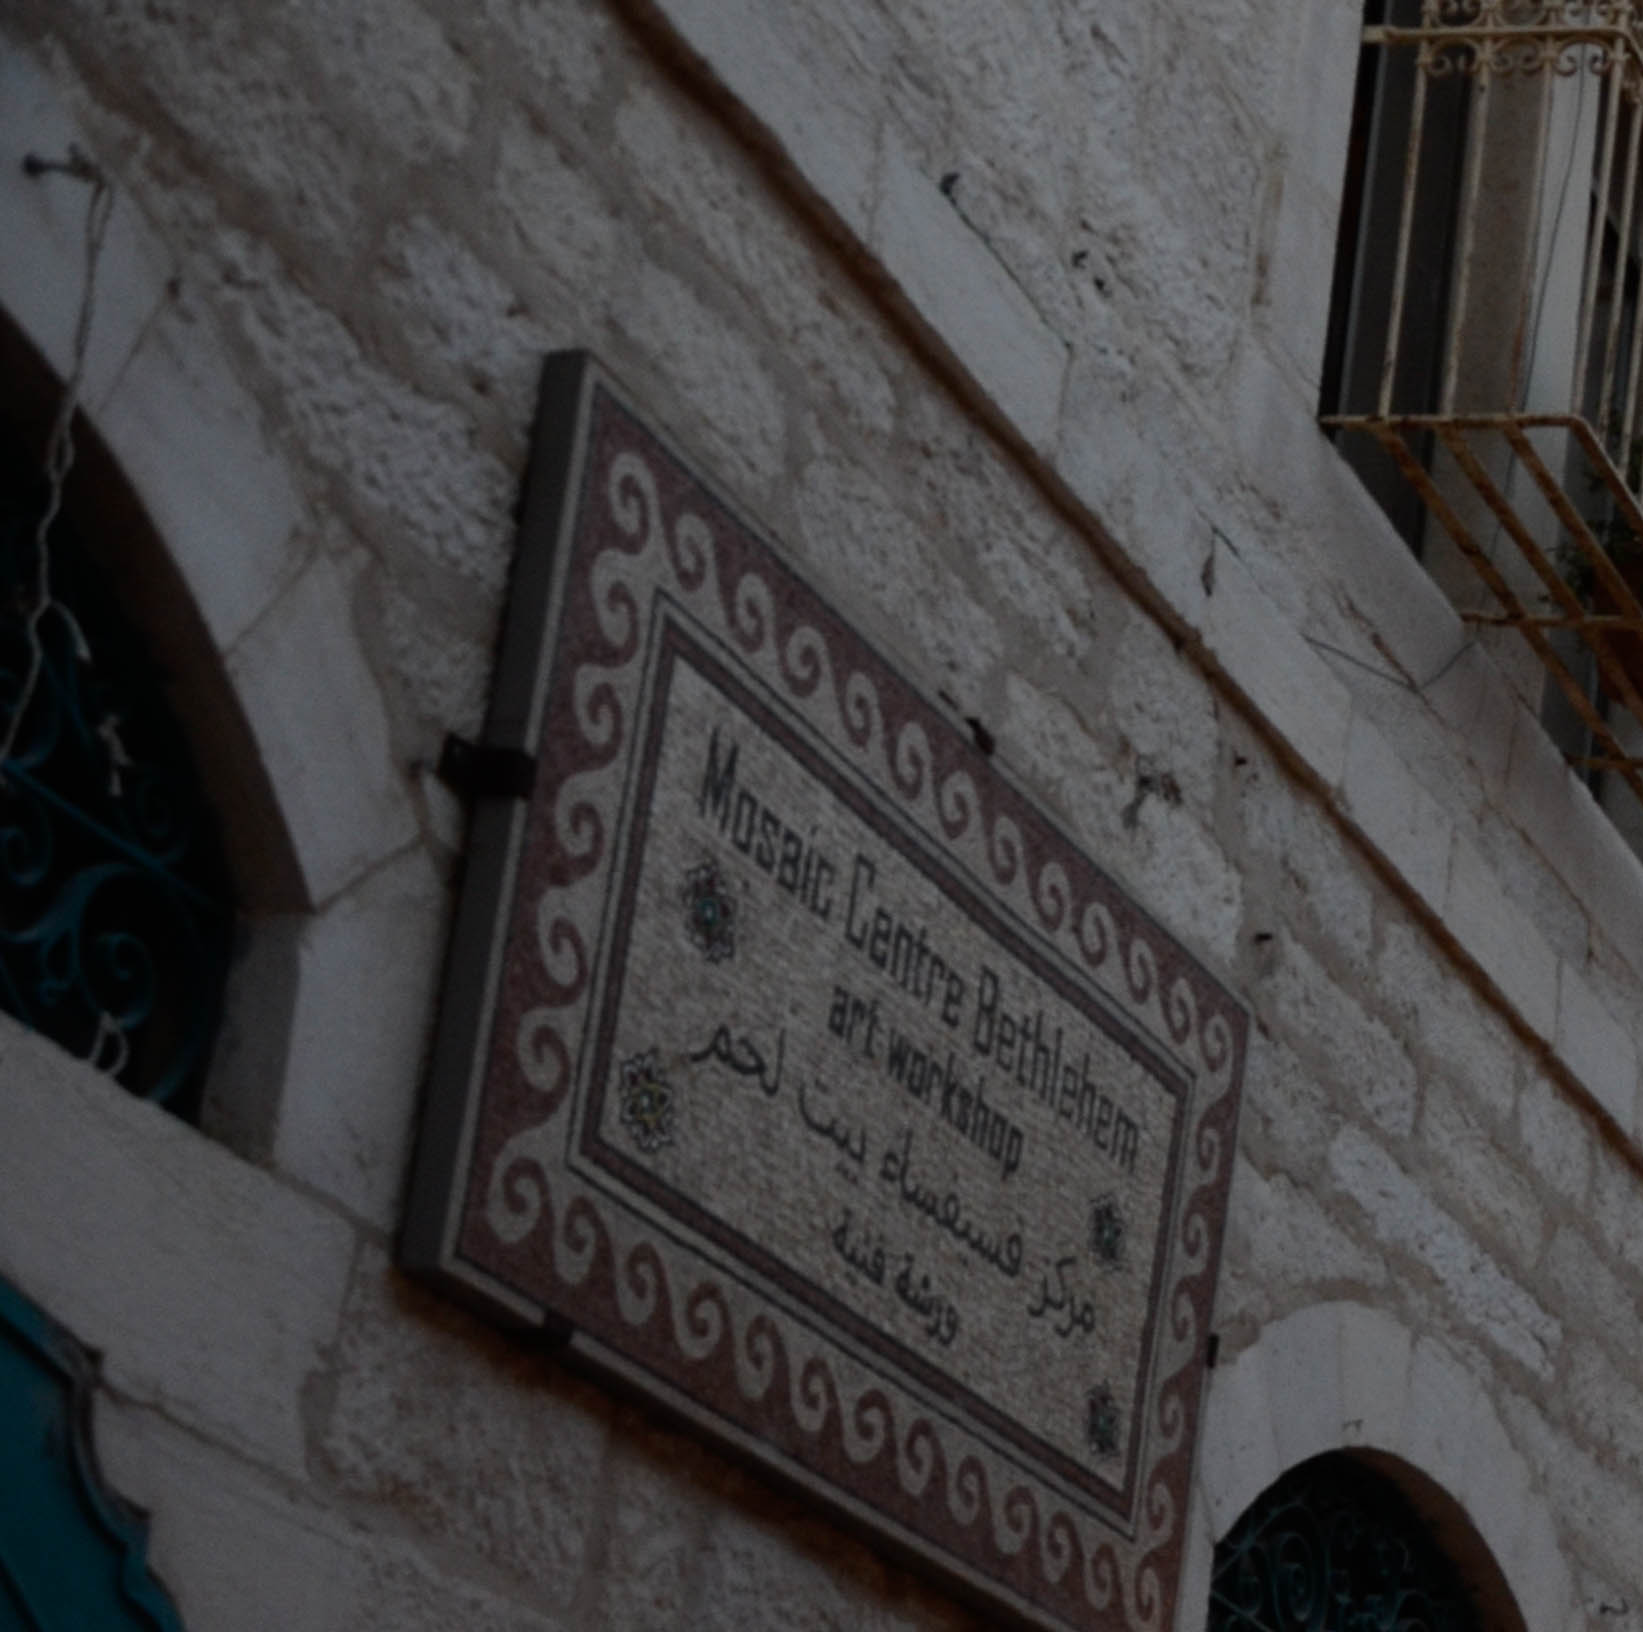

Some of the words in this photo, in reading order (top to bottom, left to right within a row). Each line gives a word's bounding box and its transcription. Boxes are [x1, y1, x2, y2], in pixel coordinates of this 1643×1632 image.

[698, 729, 835, 920] Mosaic
[845, 854, 965, 1028] Centre
[973, 966, 1137, 1173] Bethlehem
[688, 1025, 784, 1097] لحم
[828, 986, 879, 1059] art
[888, 1042, 1023, 1179] workshop
[798, 1080, 866, 1184] بيت
[831, 1208, 885, 1285] فنية
[880, 1131, 1022, 1277] فسيفساء
[895, 1254, 958, 1346] ورشة
[1028, 1257, 1095, 1338] مركز
